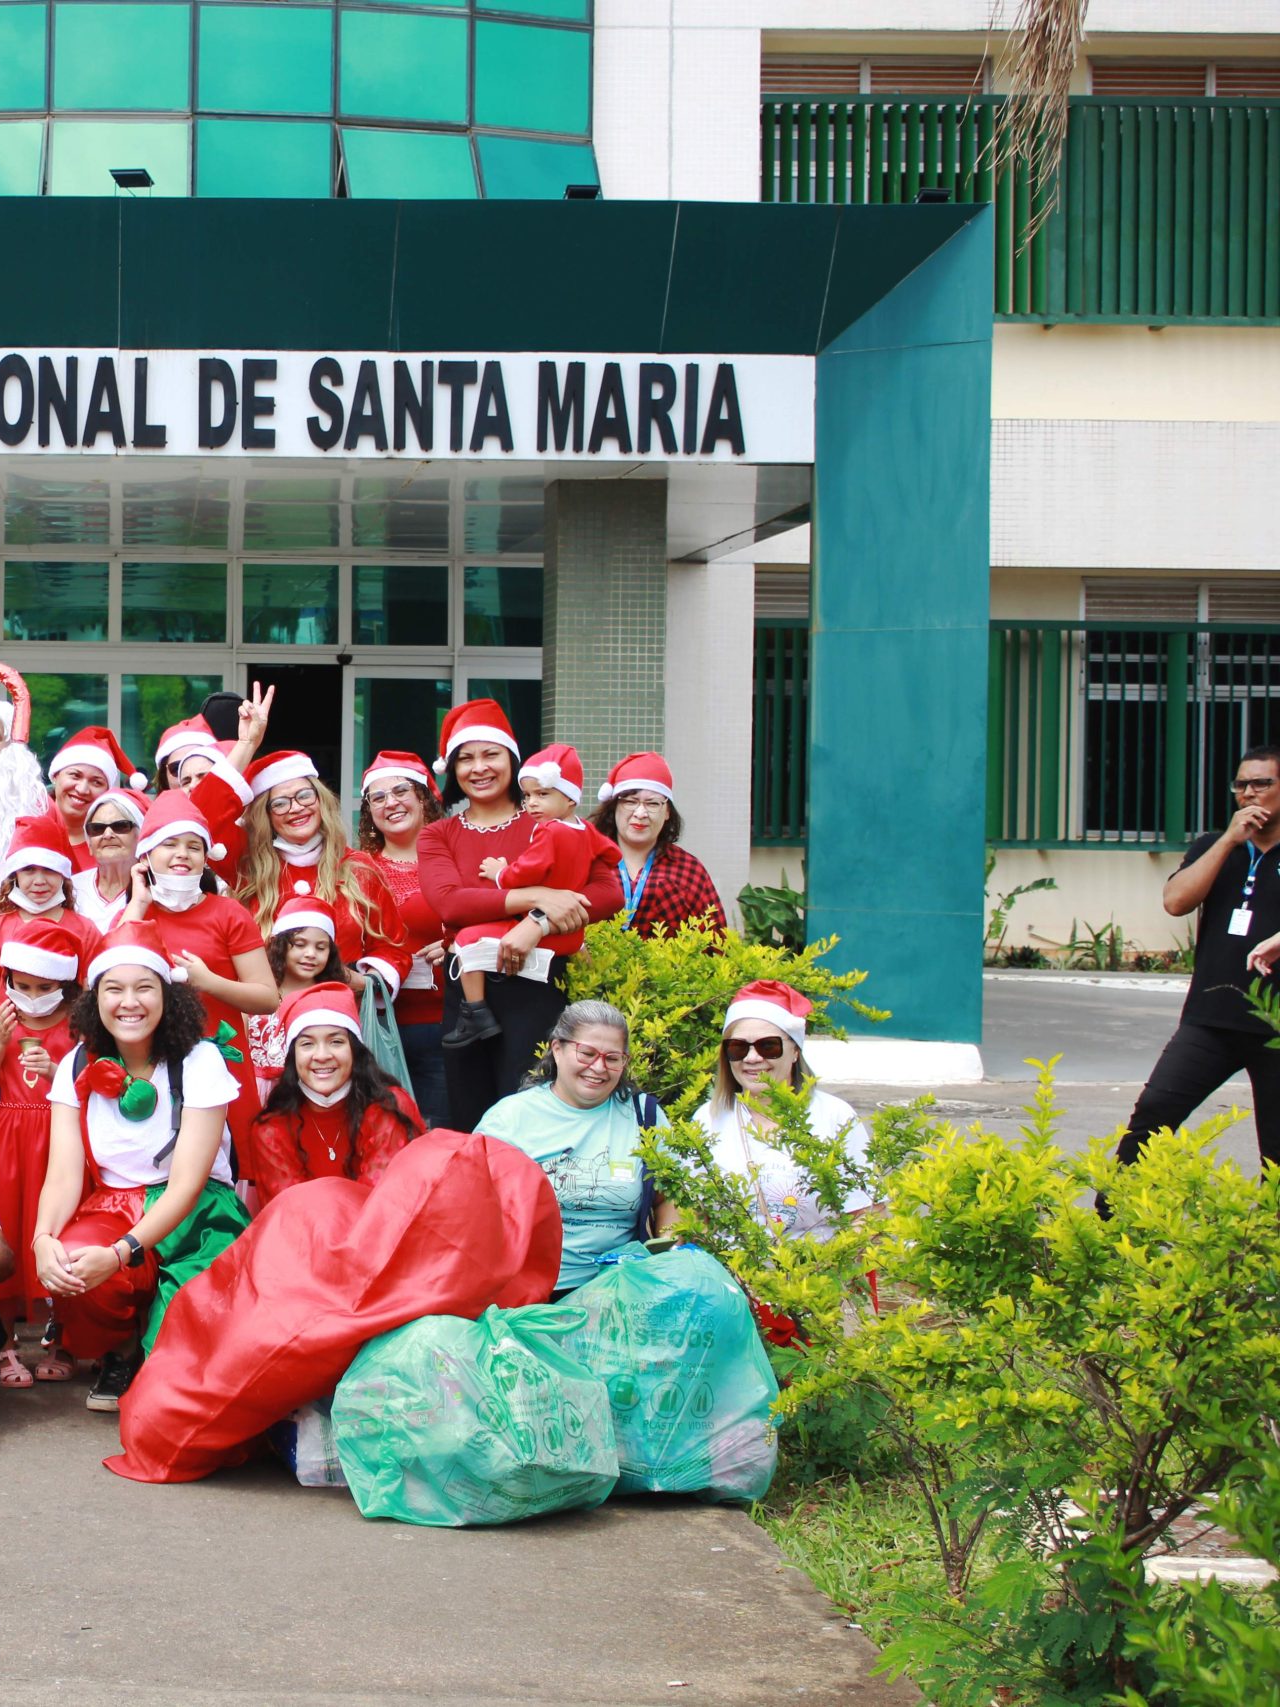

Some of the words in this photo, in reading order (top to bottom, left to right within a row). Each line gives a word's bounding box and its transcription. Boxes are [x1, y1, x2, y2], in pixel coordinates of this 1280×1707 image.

[198, 357, 277, 450] DE
[306, 356, 514, 453] SANTA
[536, 360, 746, 456] MARIA
